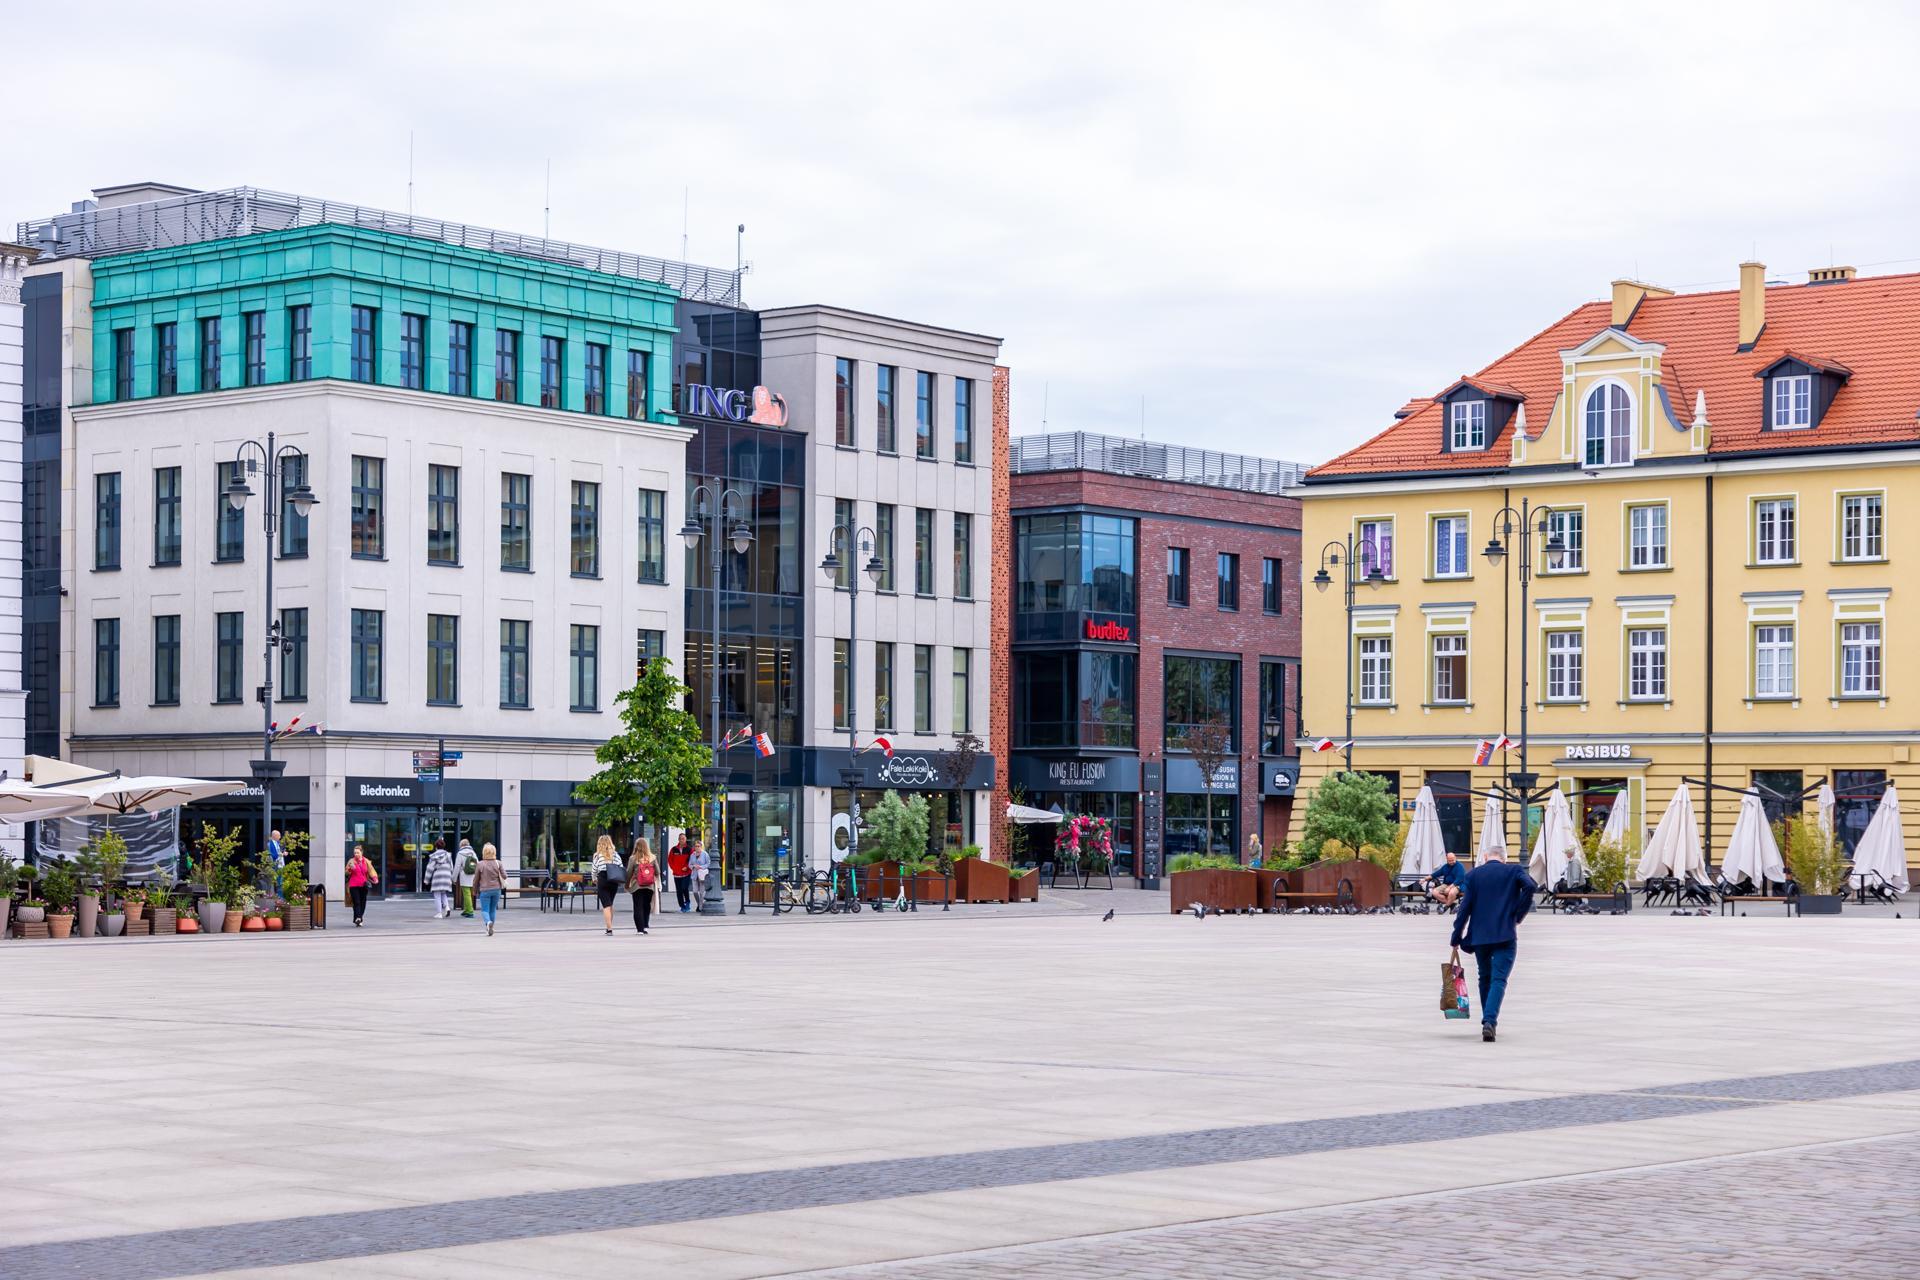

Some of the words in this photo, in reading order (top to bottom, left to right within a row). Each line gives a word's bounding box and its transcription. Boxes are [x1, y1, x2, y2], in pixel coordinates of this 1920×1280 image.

[687, 383, 747, 421] ING
[1087, 619, 1129, 640] budlex
[1566, 745, 1631, 759] PASIBUS
[1049, 761, 1066, 778] KING
[1069, 761, 1079, 778] FU
[1082, 762, 1106, 779] FUSION
[360, 784, 410, 797] Biedronka
